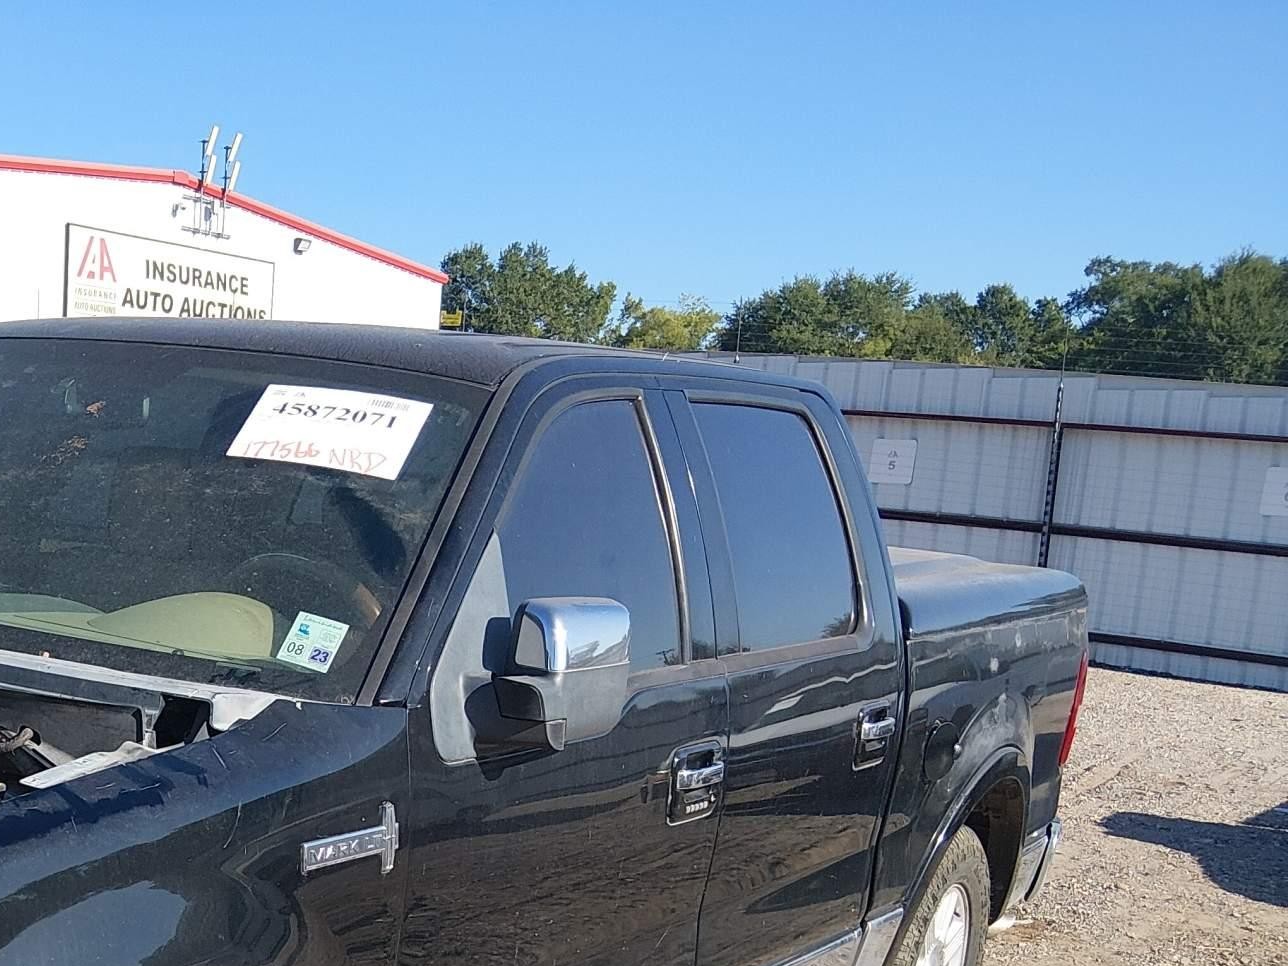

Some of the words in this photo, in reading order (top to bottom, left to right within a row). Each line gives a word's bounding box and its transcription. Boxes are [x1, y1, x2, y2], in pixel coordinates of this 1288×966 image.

[145, 259, 249, 296] INSURANCE
[121, 287, 174, 314] AUTO
[272, 401, 397, 429] 45872071
[887, 460, 896, 470] 5
[287, 641, 305, 656] 08
[310, 649, 329, 663] 23
[309, 839, 360, 864] MARK
